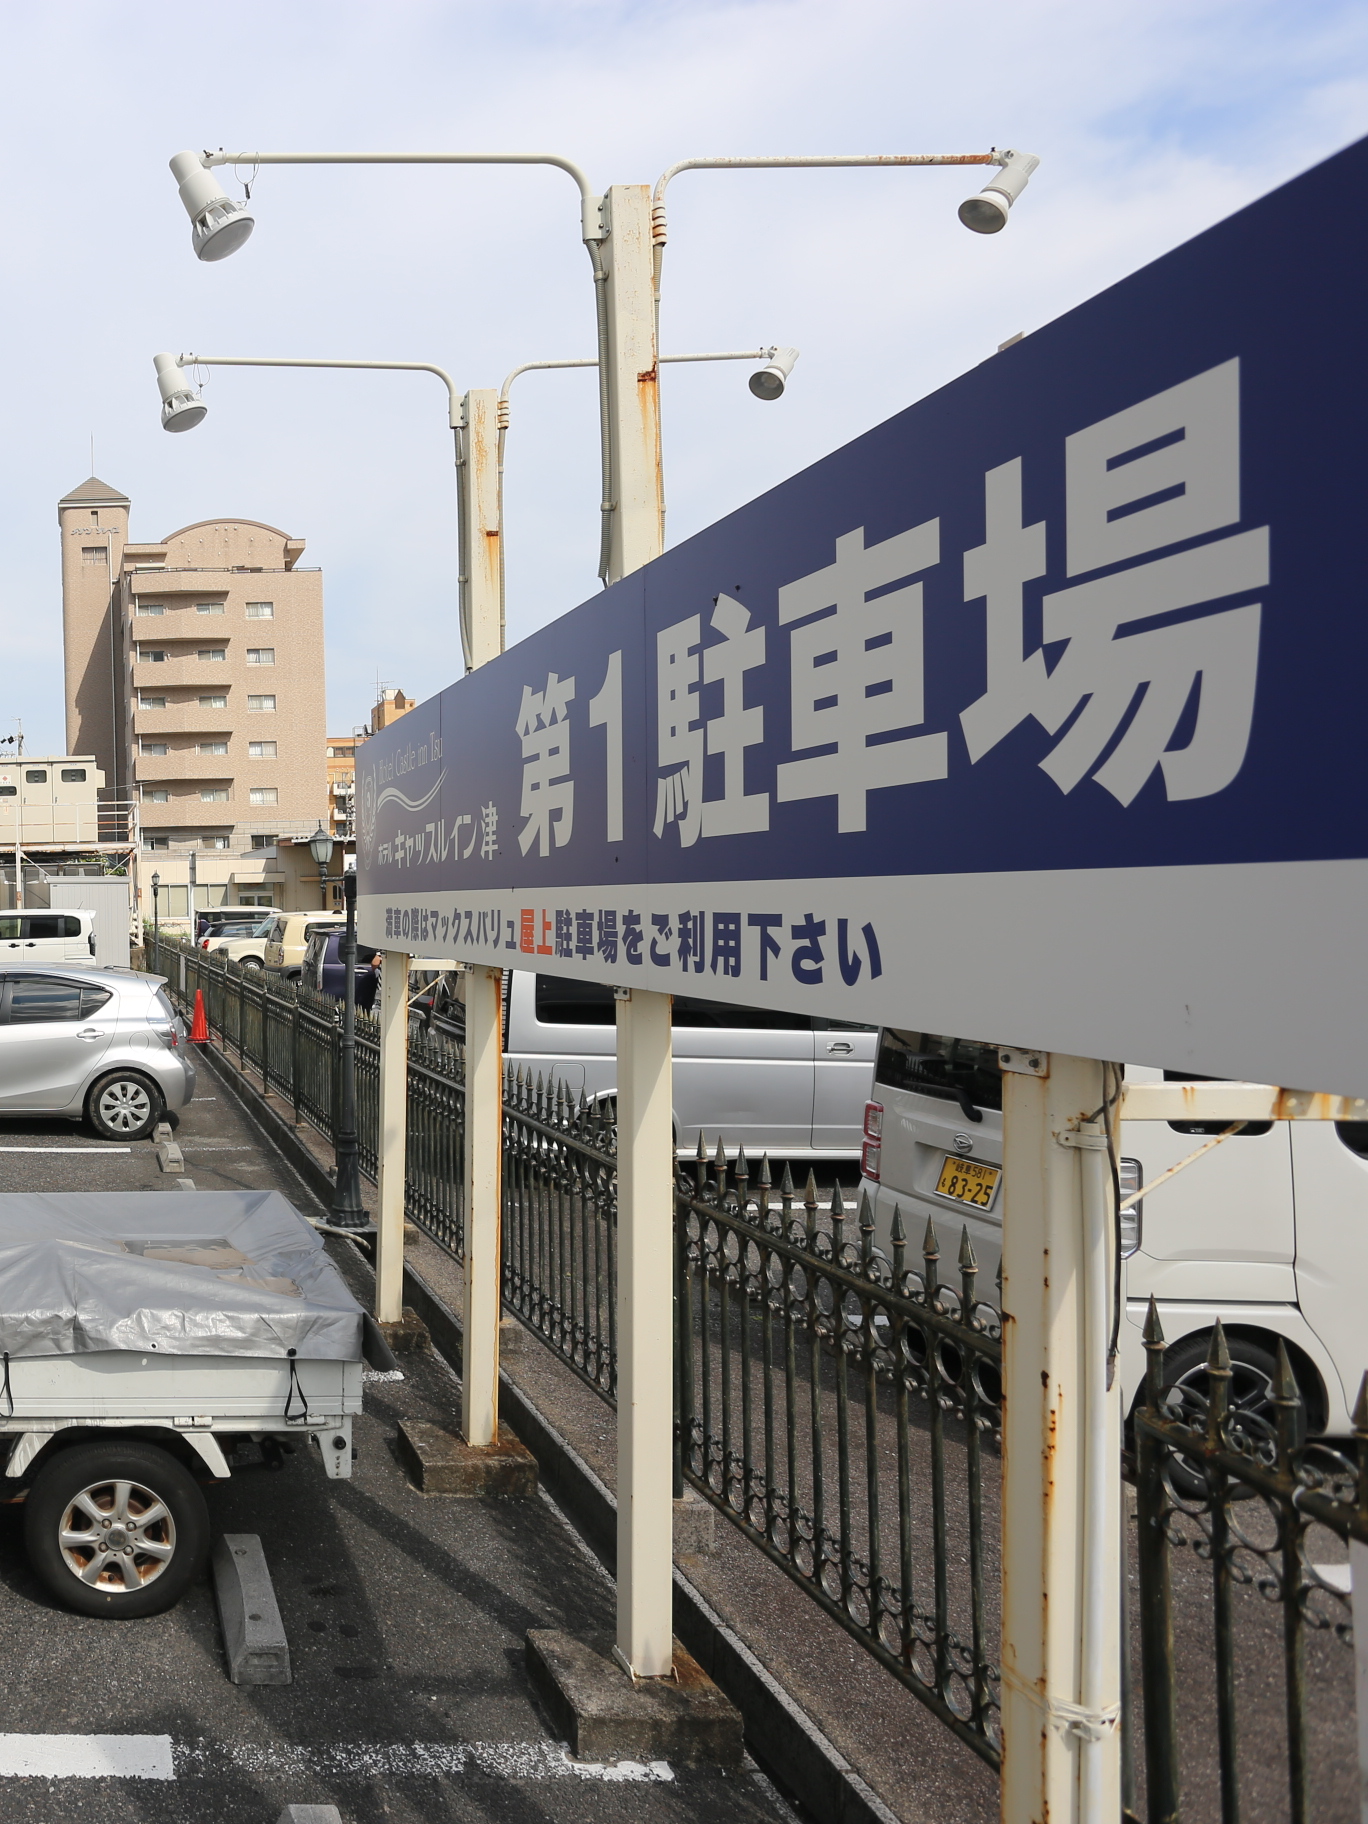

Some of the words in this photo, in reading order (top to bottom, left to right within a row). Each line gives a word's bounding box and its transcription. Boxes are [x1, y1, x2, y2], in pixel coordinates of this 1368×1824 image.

[516, 356, 1270, 858] 第1駐車場
[378, 753, 394, 785] Hotel
[395, 742, 416, 776] Castle
[417, 743, 428, 766] inn
[430, 731, 443, 761] Tsu
